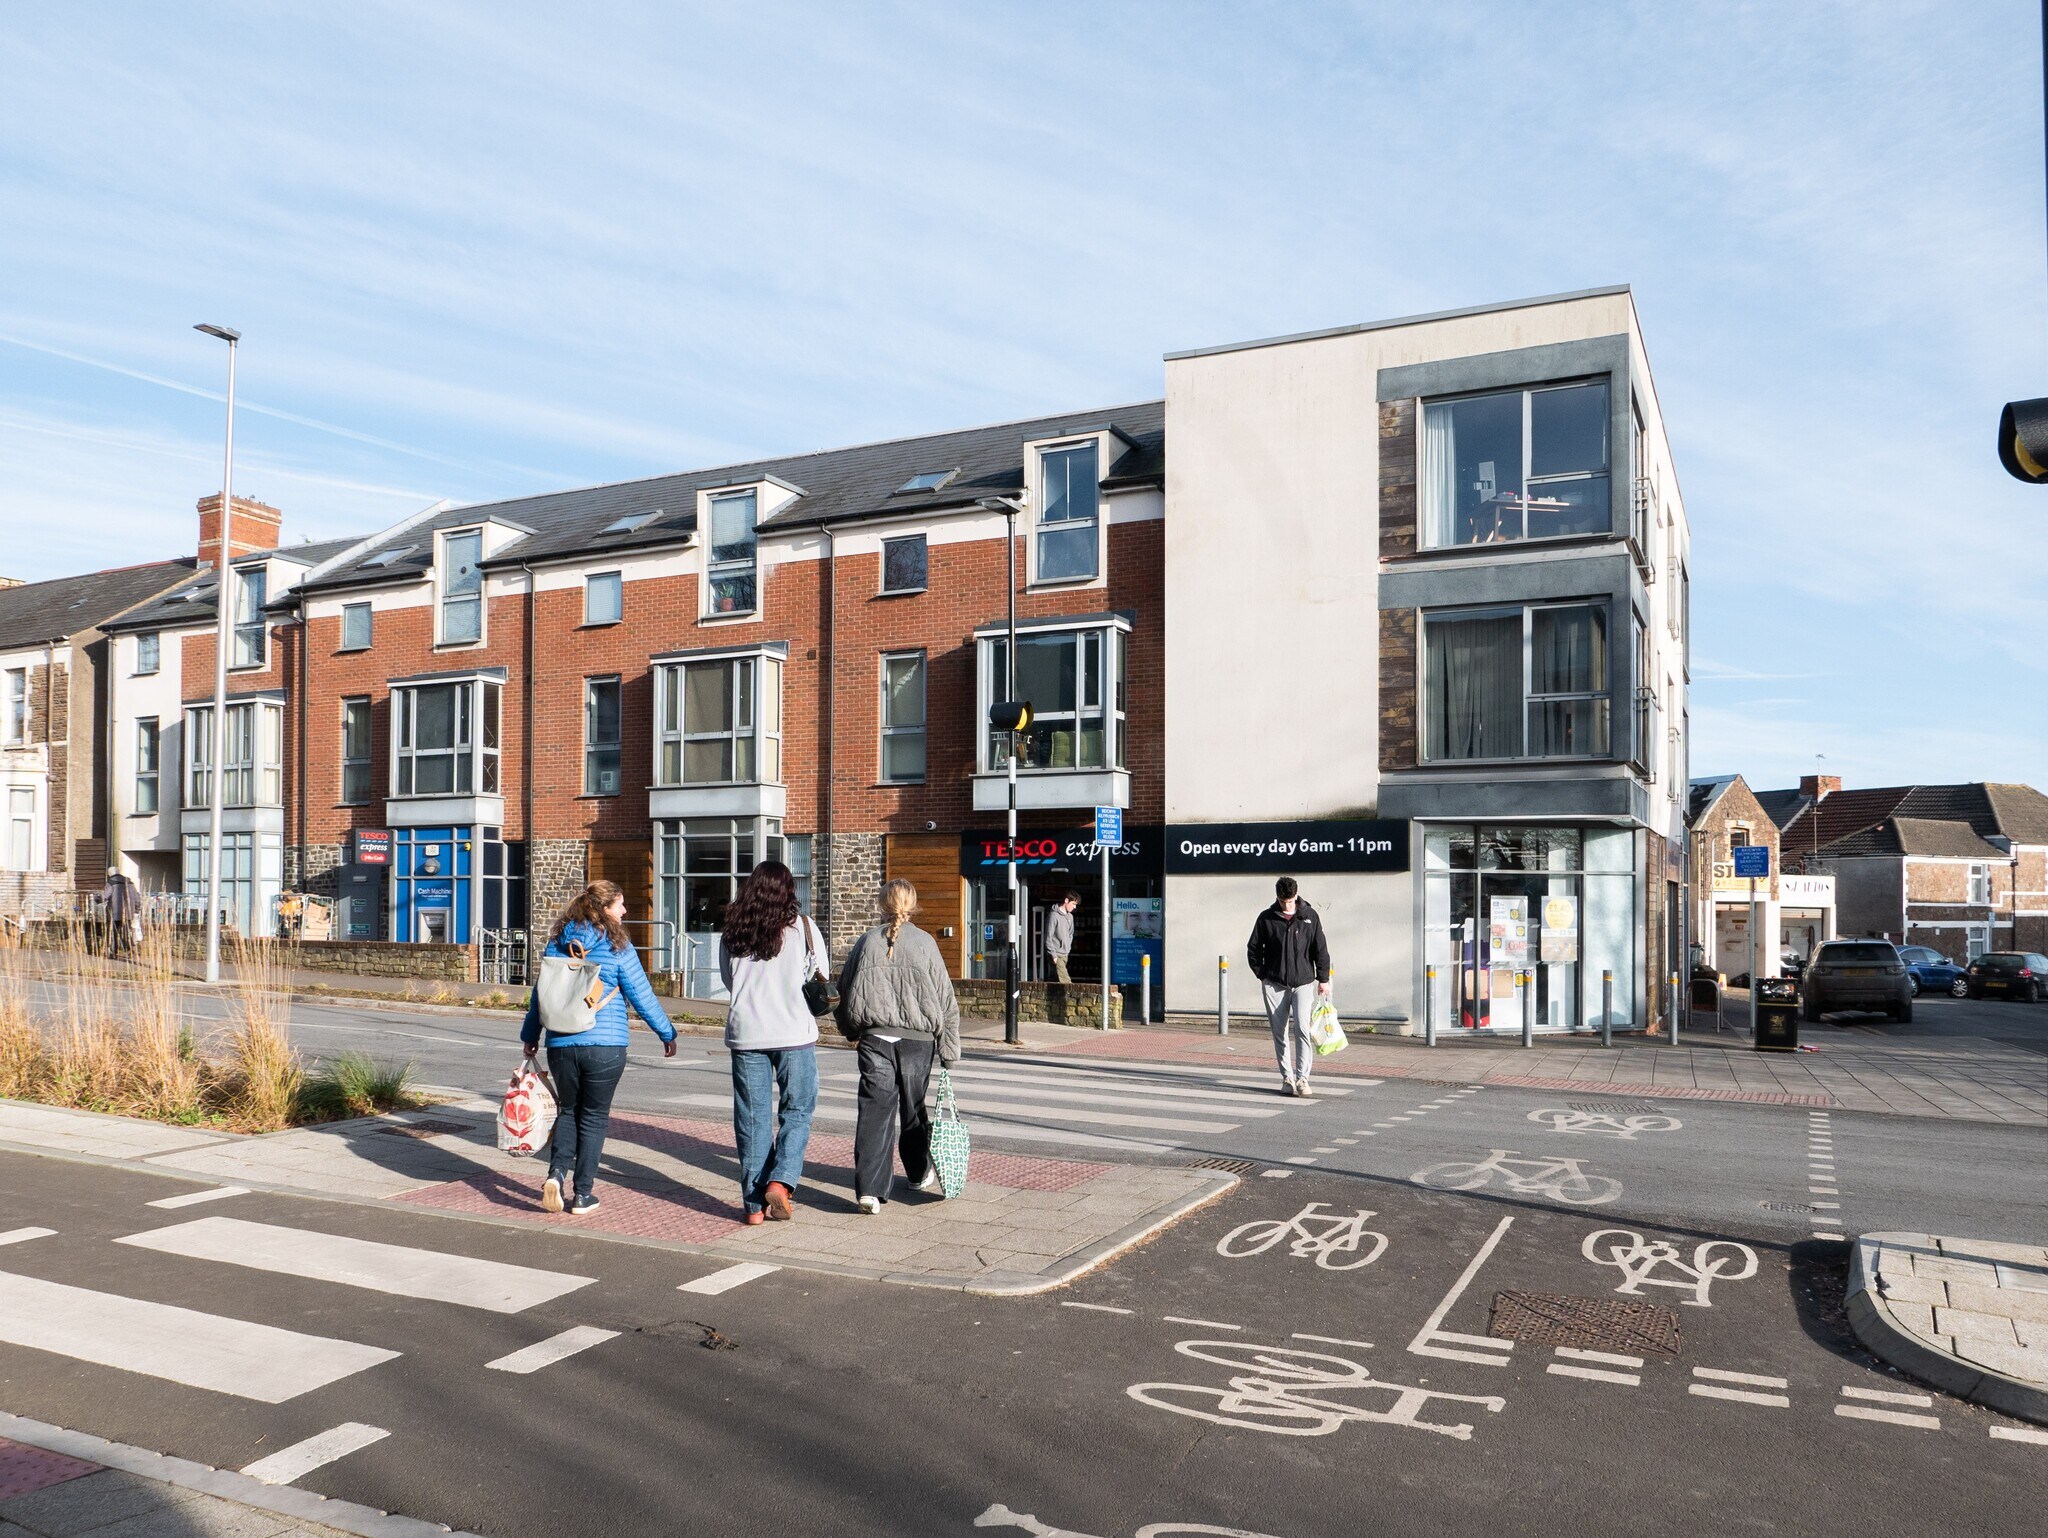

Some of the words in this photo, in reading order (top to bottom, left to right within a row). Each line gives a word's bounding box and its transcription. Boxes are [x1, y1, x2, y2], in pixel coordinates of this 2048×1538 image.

[359, 832, 388, 840] TESCO
[360, 844, 388, 852] express
[980, 839, 1057, 857] TESCO
[1065, 841, 1141, 861] expess
[1180, 840, 1221, 857] Open
[1223, 841, 1265, 856] every
[1268, 839, 1297, 856] day
[1299, 838, 1334, 853] 6am
[1347, 837, 1392, 855] 11pm
[1116, 901, 1140, 910] Hello.
[536, 1092, 550, 1100] This
